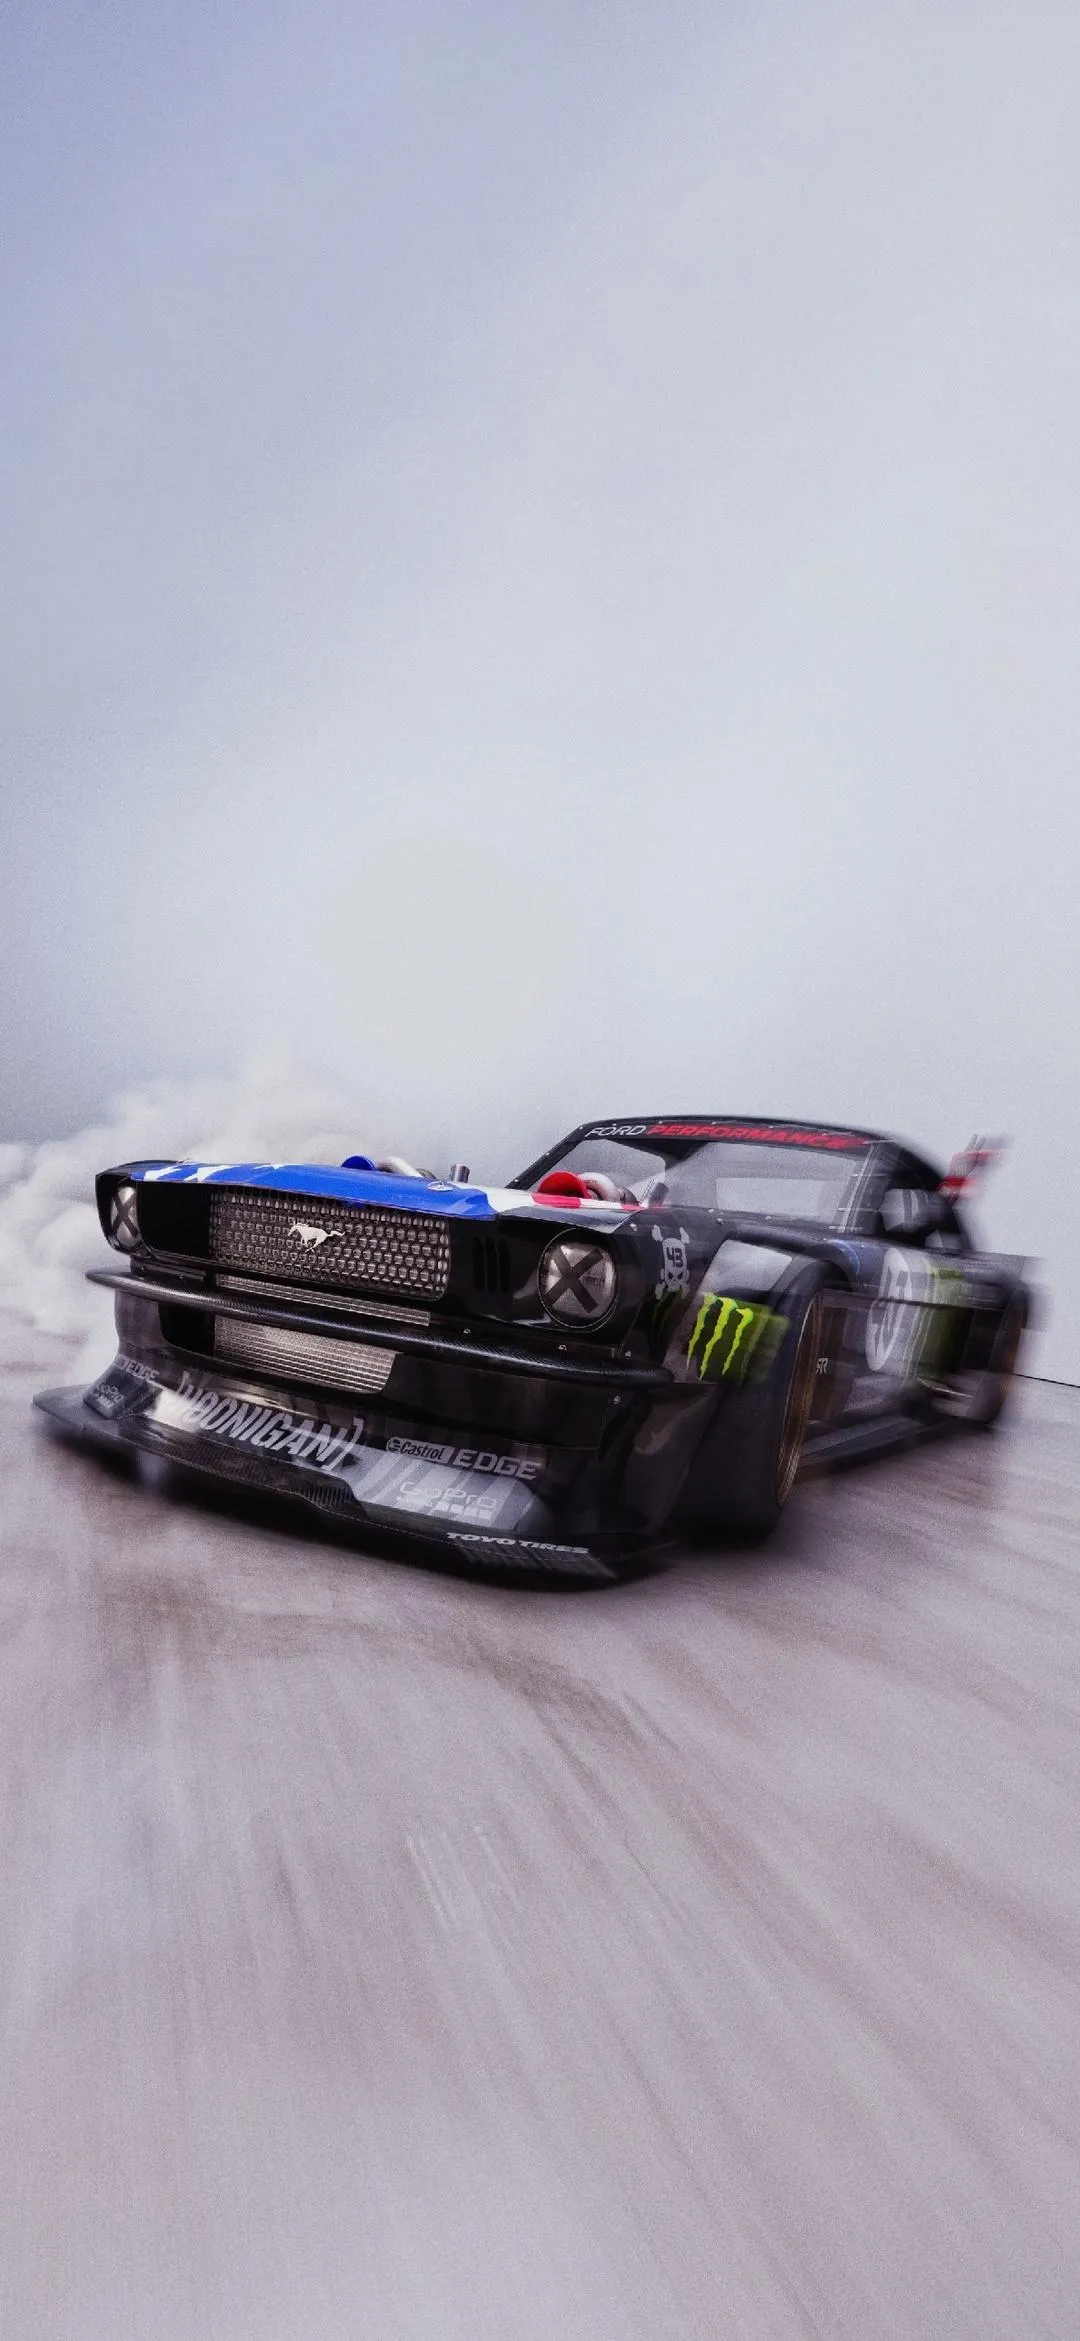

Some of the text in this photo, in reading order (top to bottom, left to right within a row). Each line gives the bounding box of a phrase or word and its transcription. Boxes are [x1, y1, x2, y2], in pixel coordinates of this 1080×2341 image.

[584, 1123, 850, 1151] FORD PERFORMANCE
[666, 1246, 684, 1268] 43
[126, 1359, 160, 1380] EDGE
[400, 1440, 542, 1480] Castrol EDGE
[446, 1532, 589, 1554] TOYO TIRES
